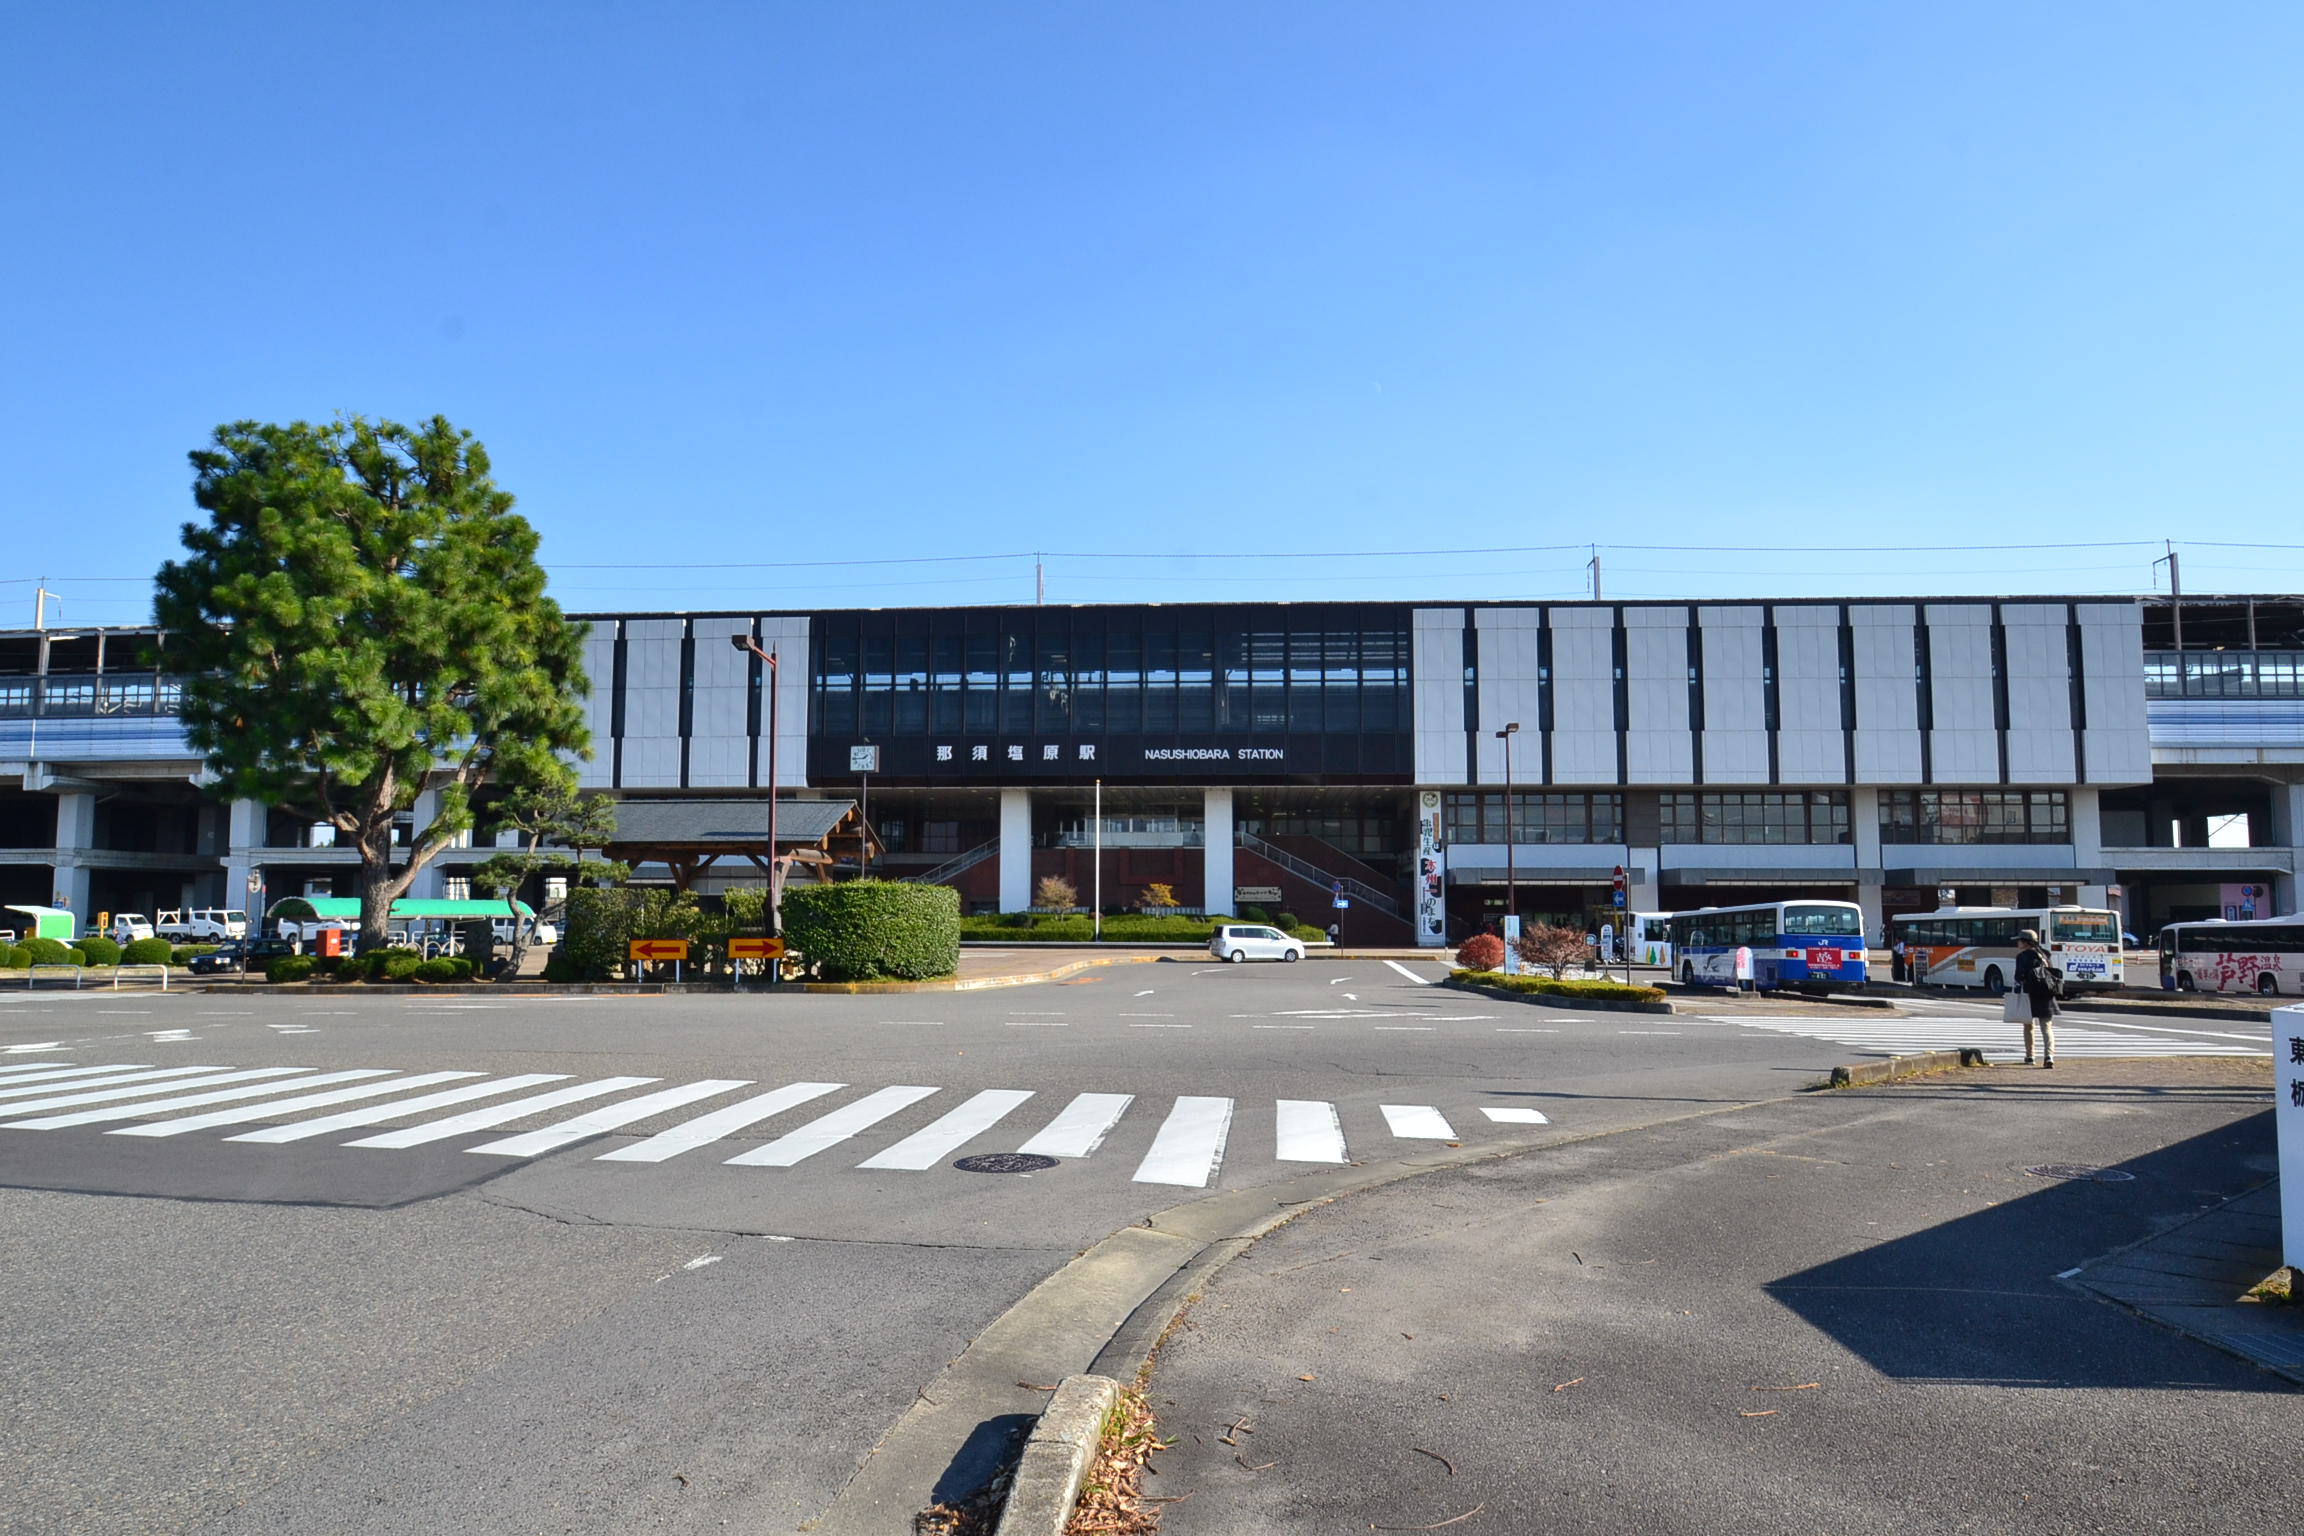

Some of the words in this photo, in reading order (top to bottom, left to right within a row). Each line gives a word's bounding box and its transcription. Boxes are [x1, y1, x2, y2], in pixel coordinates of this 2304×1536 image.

[936, 745, 1095, 761] 那須塩原駅
[1145, 749, 1230, 760] NASUSHIOBARA
[1238, 749, 1284, 760] STATION
[2065, 943, 2105, 953] TOYA
